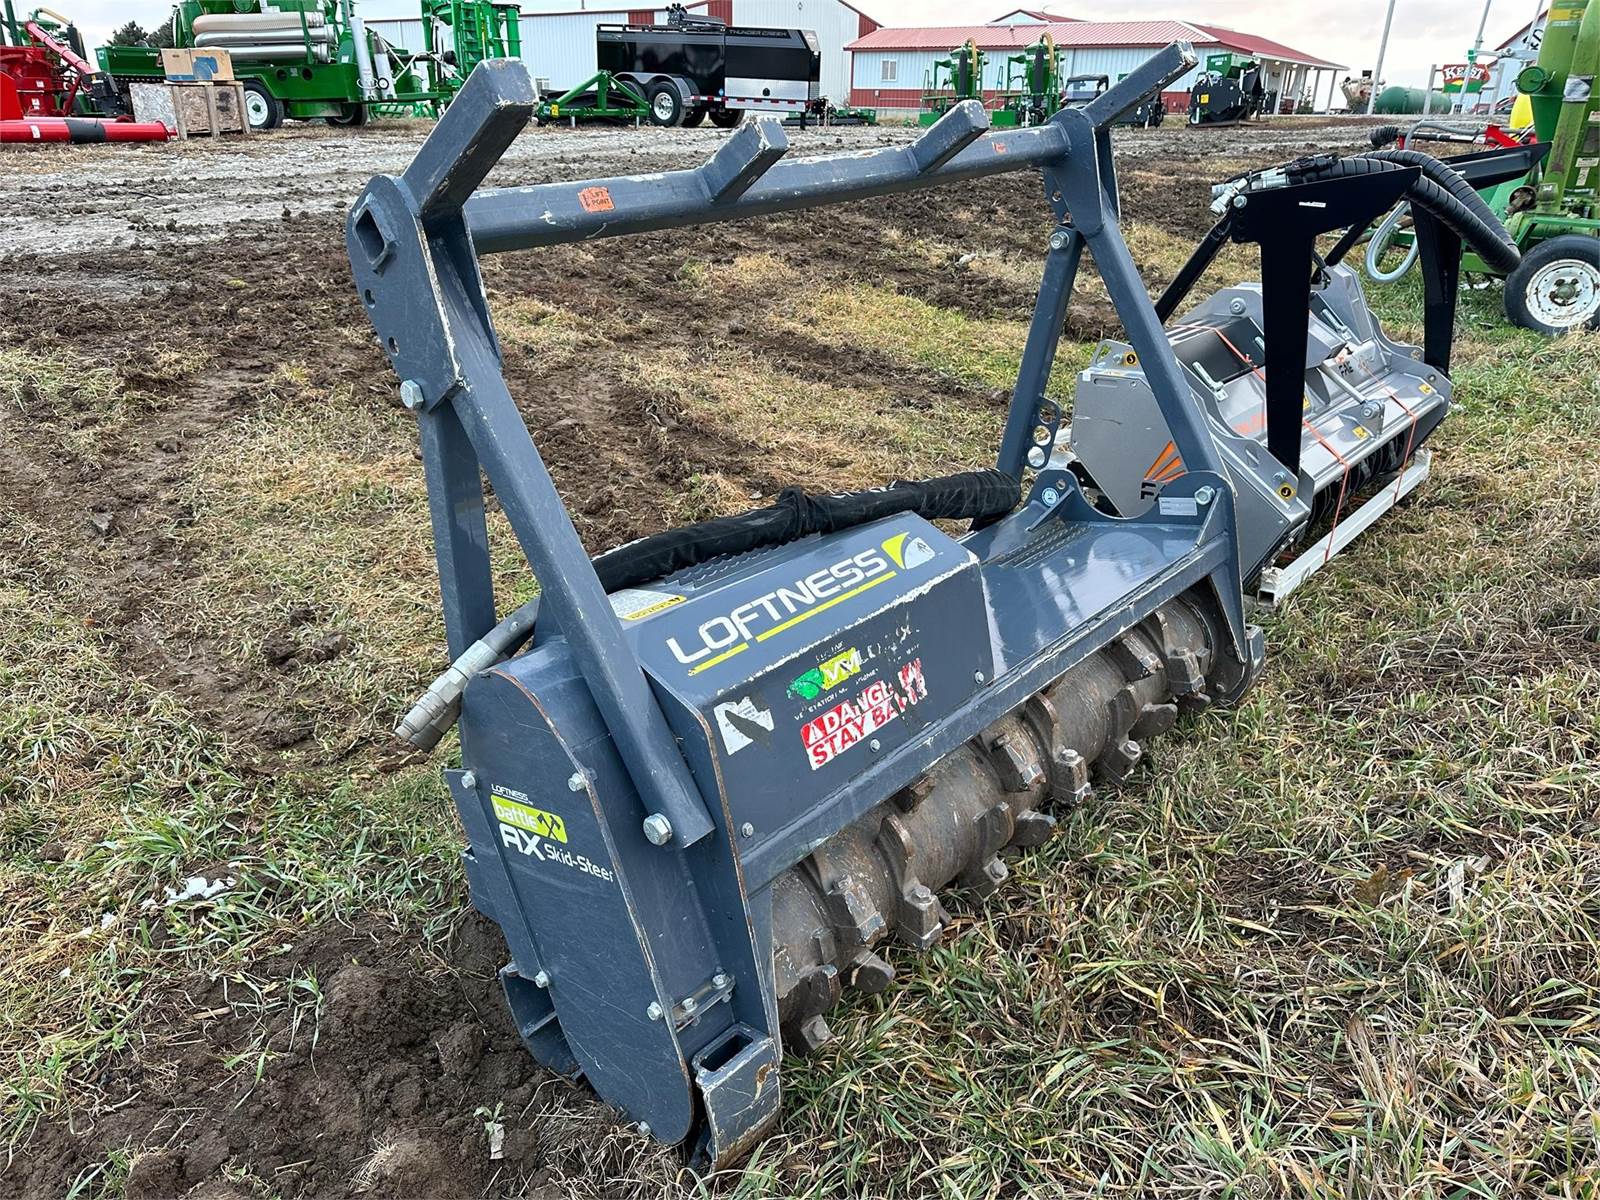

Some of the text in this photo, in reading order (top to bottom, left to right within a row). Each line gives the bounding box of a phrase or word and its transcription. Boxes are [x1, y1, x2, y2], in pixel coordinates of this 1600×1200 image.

[666, 548, 888, 664] LOFTNESS
[811, 714, 867, 765] STAY
[491, 783, 529, 801] LOFTNESS
[494, 802, 539, 830] battle
[499, 822, 614, 882] AX Skid-Steer
